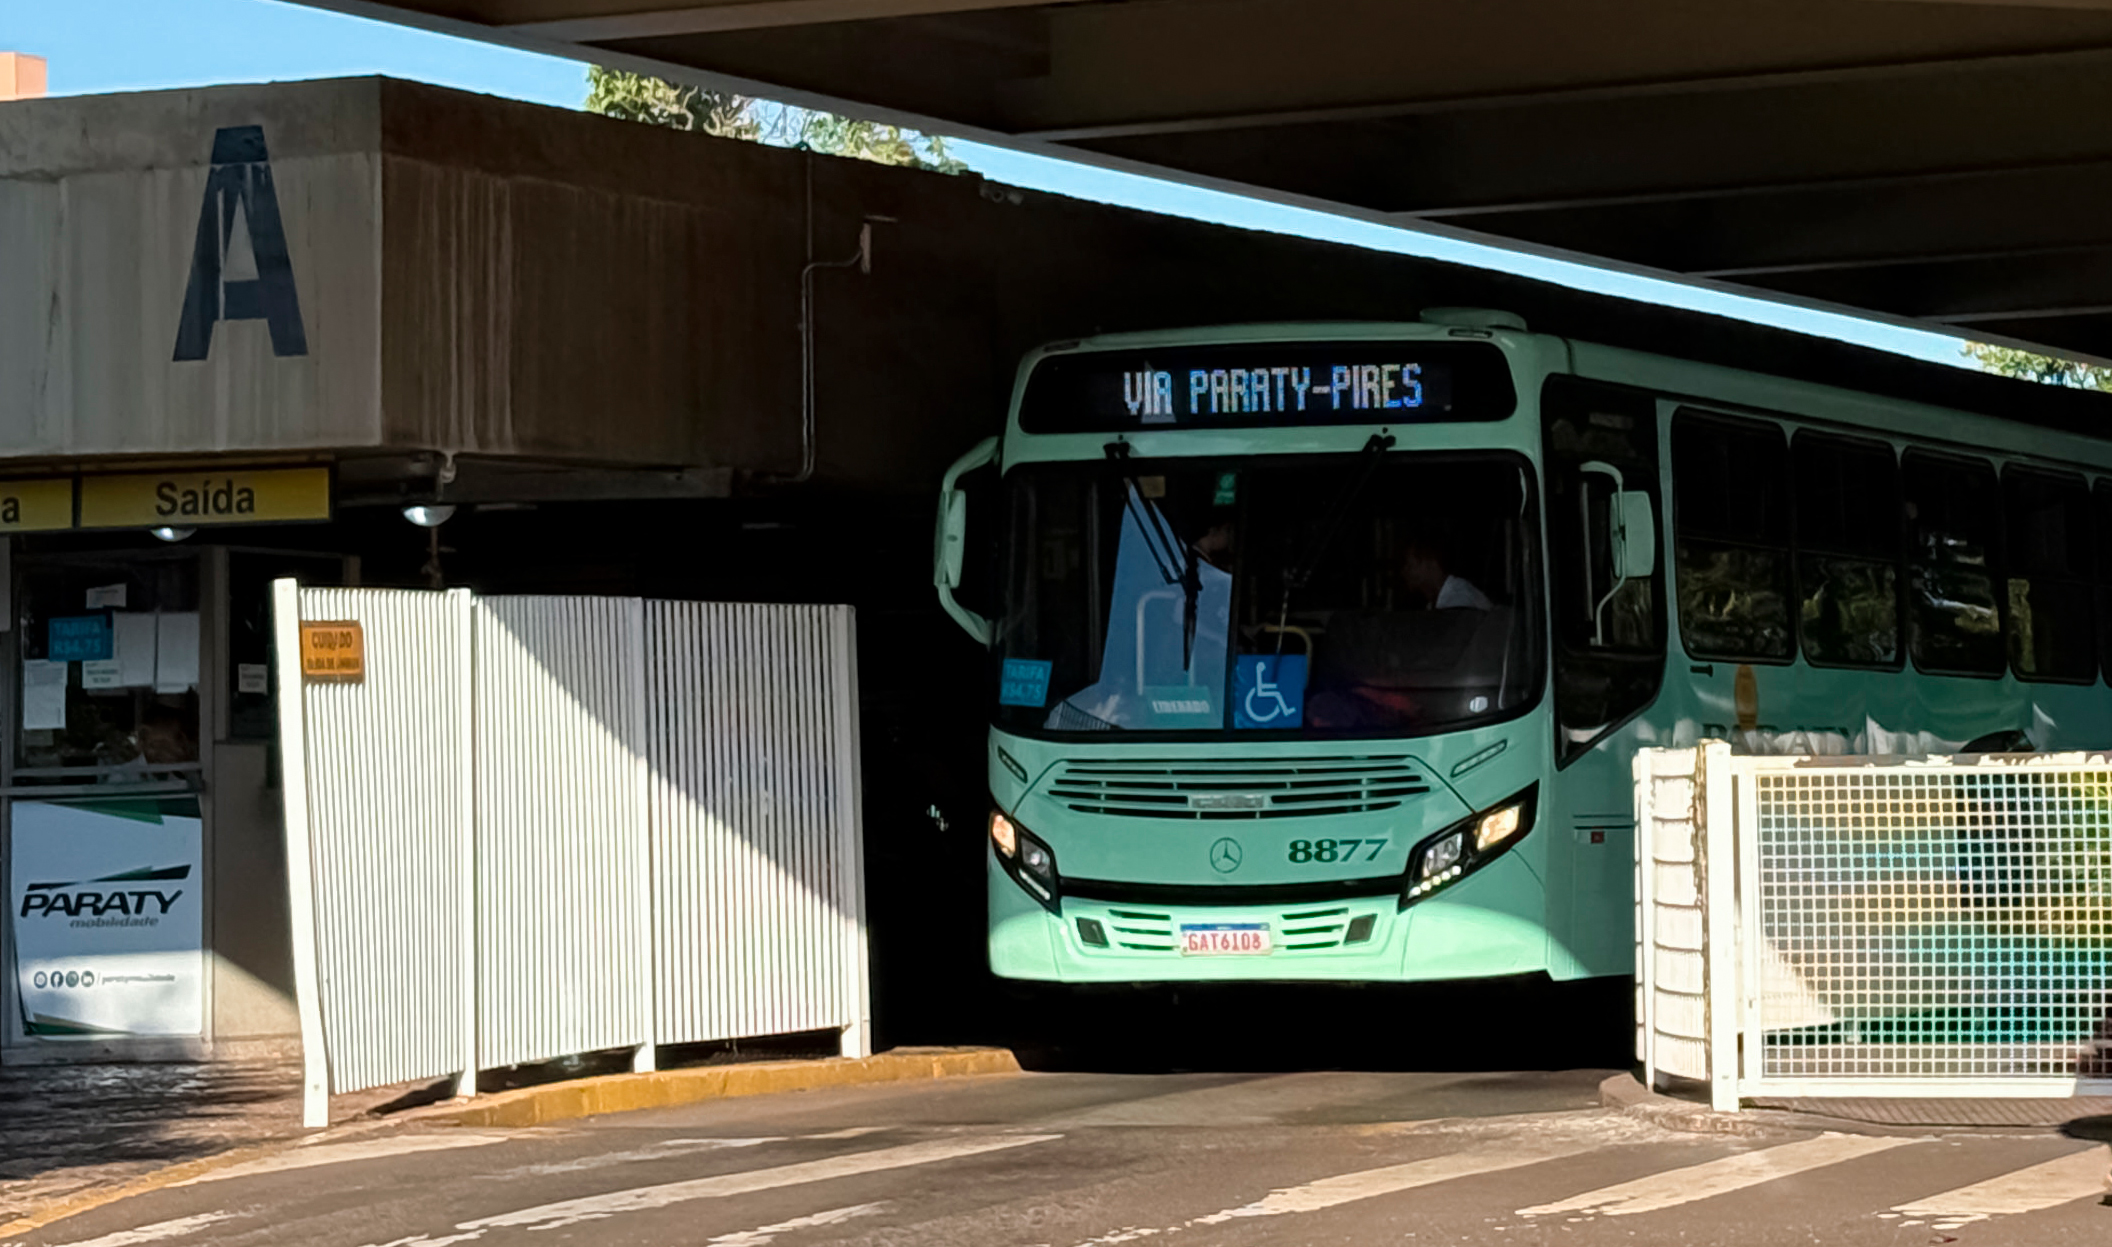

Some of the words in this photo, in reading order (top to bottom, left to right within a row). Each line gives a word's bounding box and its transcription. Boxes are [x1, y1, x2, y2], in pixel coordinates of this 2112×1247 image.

[172, 125, 309, 362] A
[1123, 371, 1173, 415] VIA
[1190, 363, 1422, 414] PARATY-PIRES
[155, 479, 255, 516] Saída
[1005, 664, 1044, 680] TARIFA
[1288, 838, 1388, 864] 8877
[20, 890, 183, 917] PARATY
[69, 916, 159, 928] mobilidade
